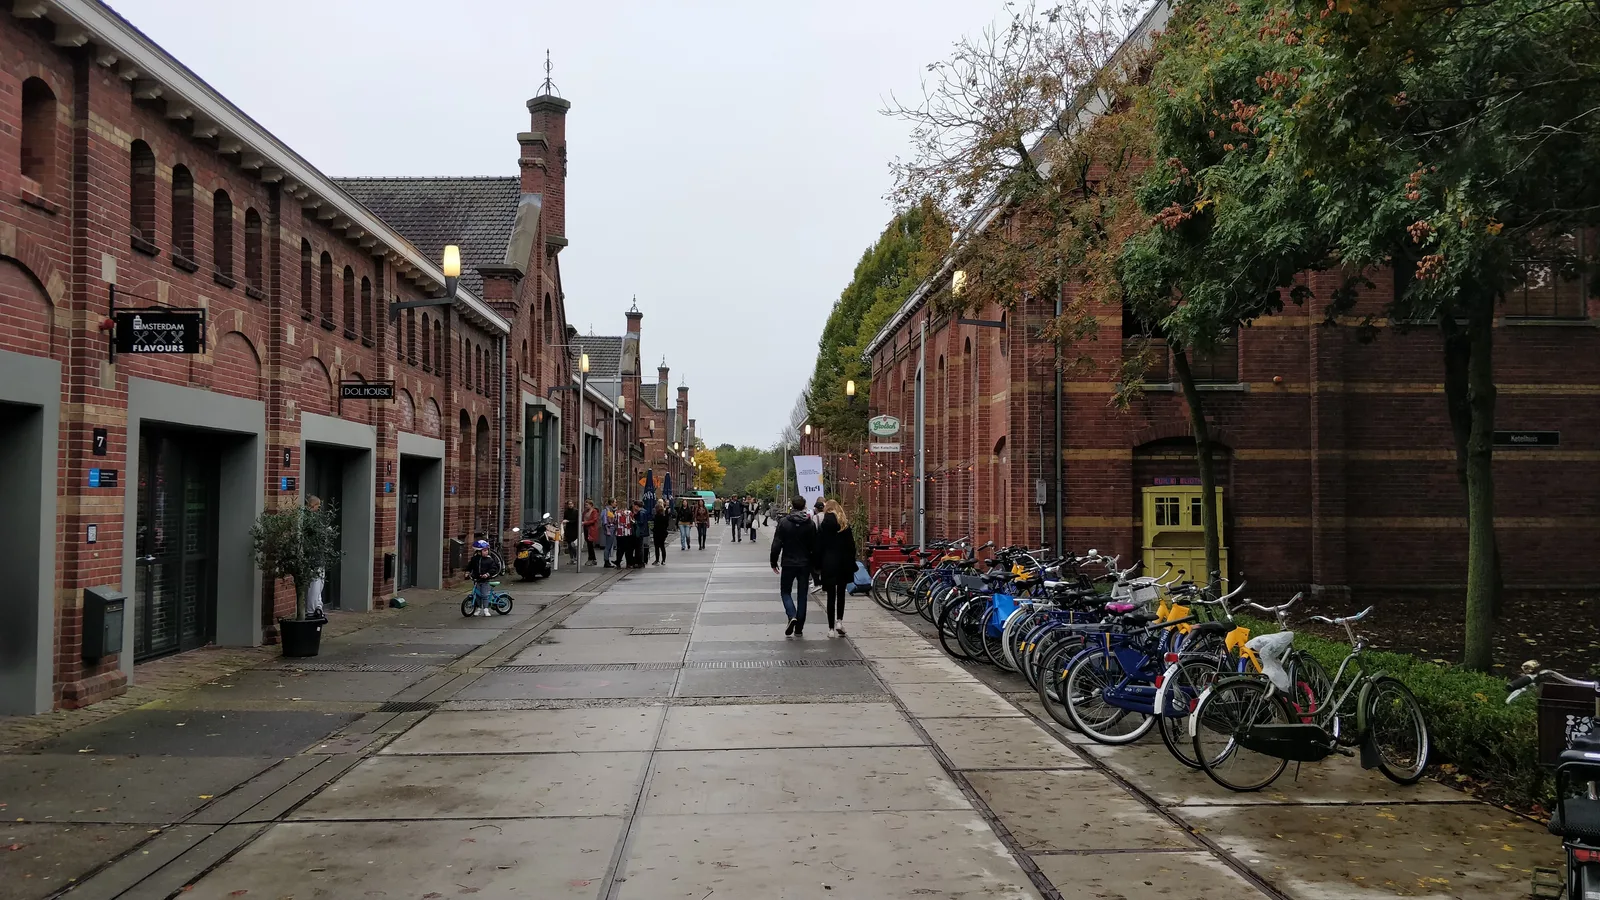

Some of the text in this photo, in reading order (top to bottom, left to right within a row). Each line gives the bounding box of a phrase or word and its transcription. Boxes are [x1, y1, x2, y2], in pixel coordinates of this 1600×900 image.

[873, 421, 897, 430] Grolsch
[97, 436, 104, 448] 7
[285, 453, 290, 462] 9
